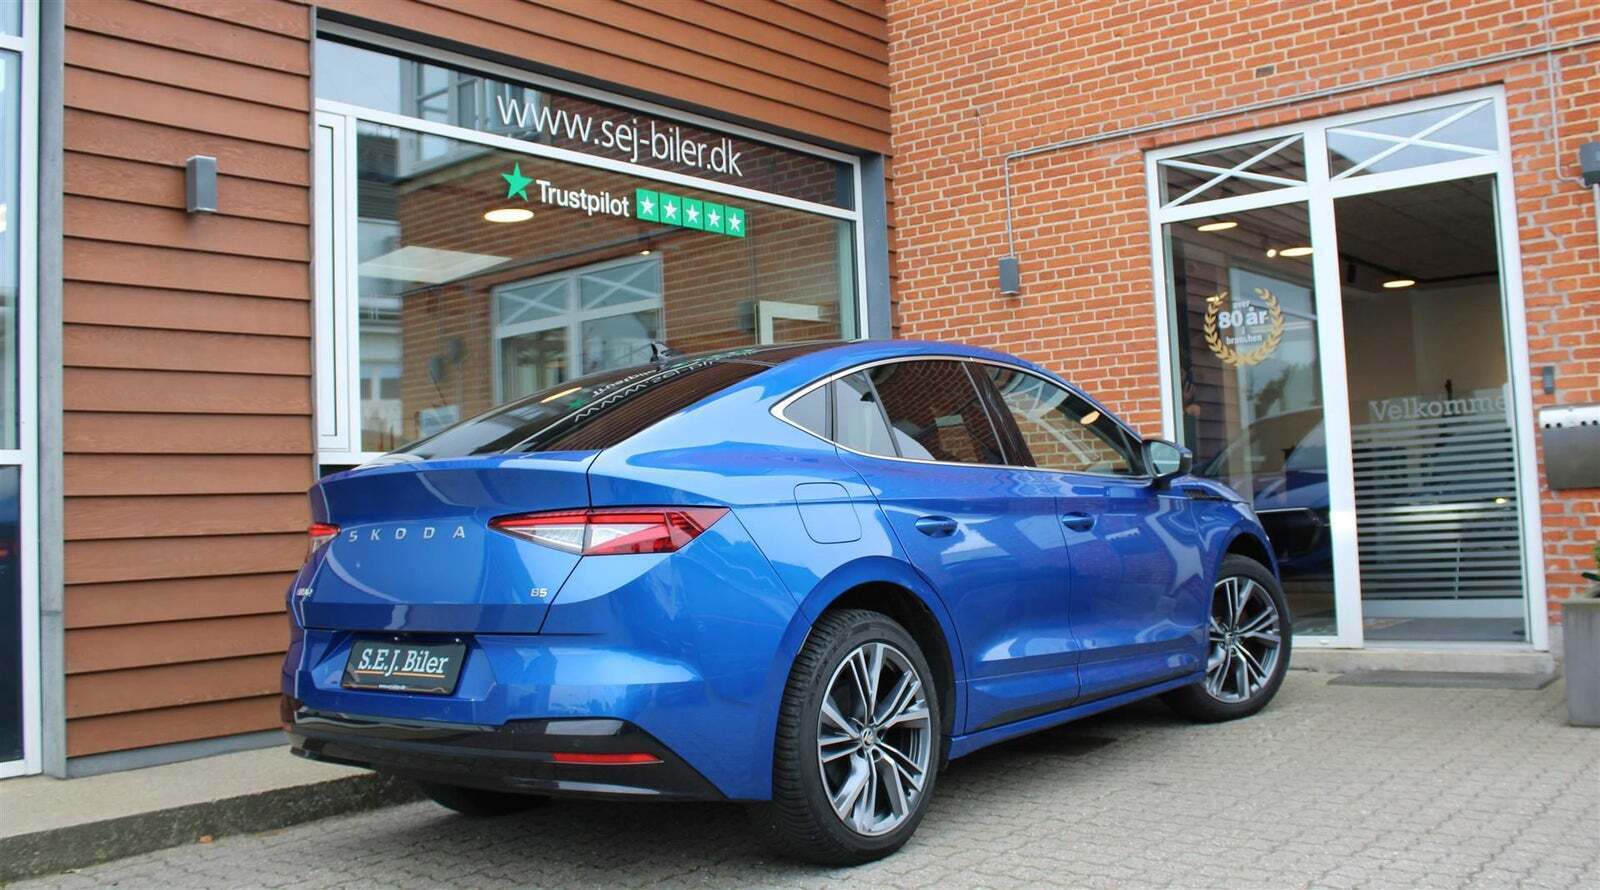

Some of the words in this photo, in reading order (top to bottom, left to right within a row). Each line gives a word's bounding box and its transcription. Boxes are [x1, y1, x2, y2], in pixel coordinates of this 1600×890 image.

[497, 95, 743, 176] www.sej-biler.dk
[535, 179, 630, 217] Trustpilot
[1218, 310, 1243, 329] 80
[1246, 306, 1268, 325] år
[530, 587, 548, 598] 85
[357, 648, 401, 677] S.E.J.
[401, 650, 449, 674] Biler
